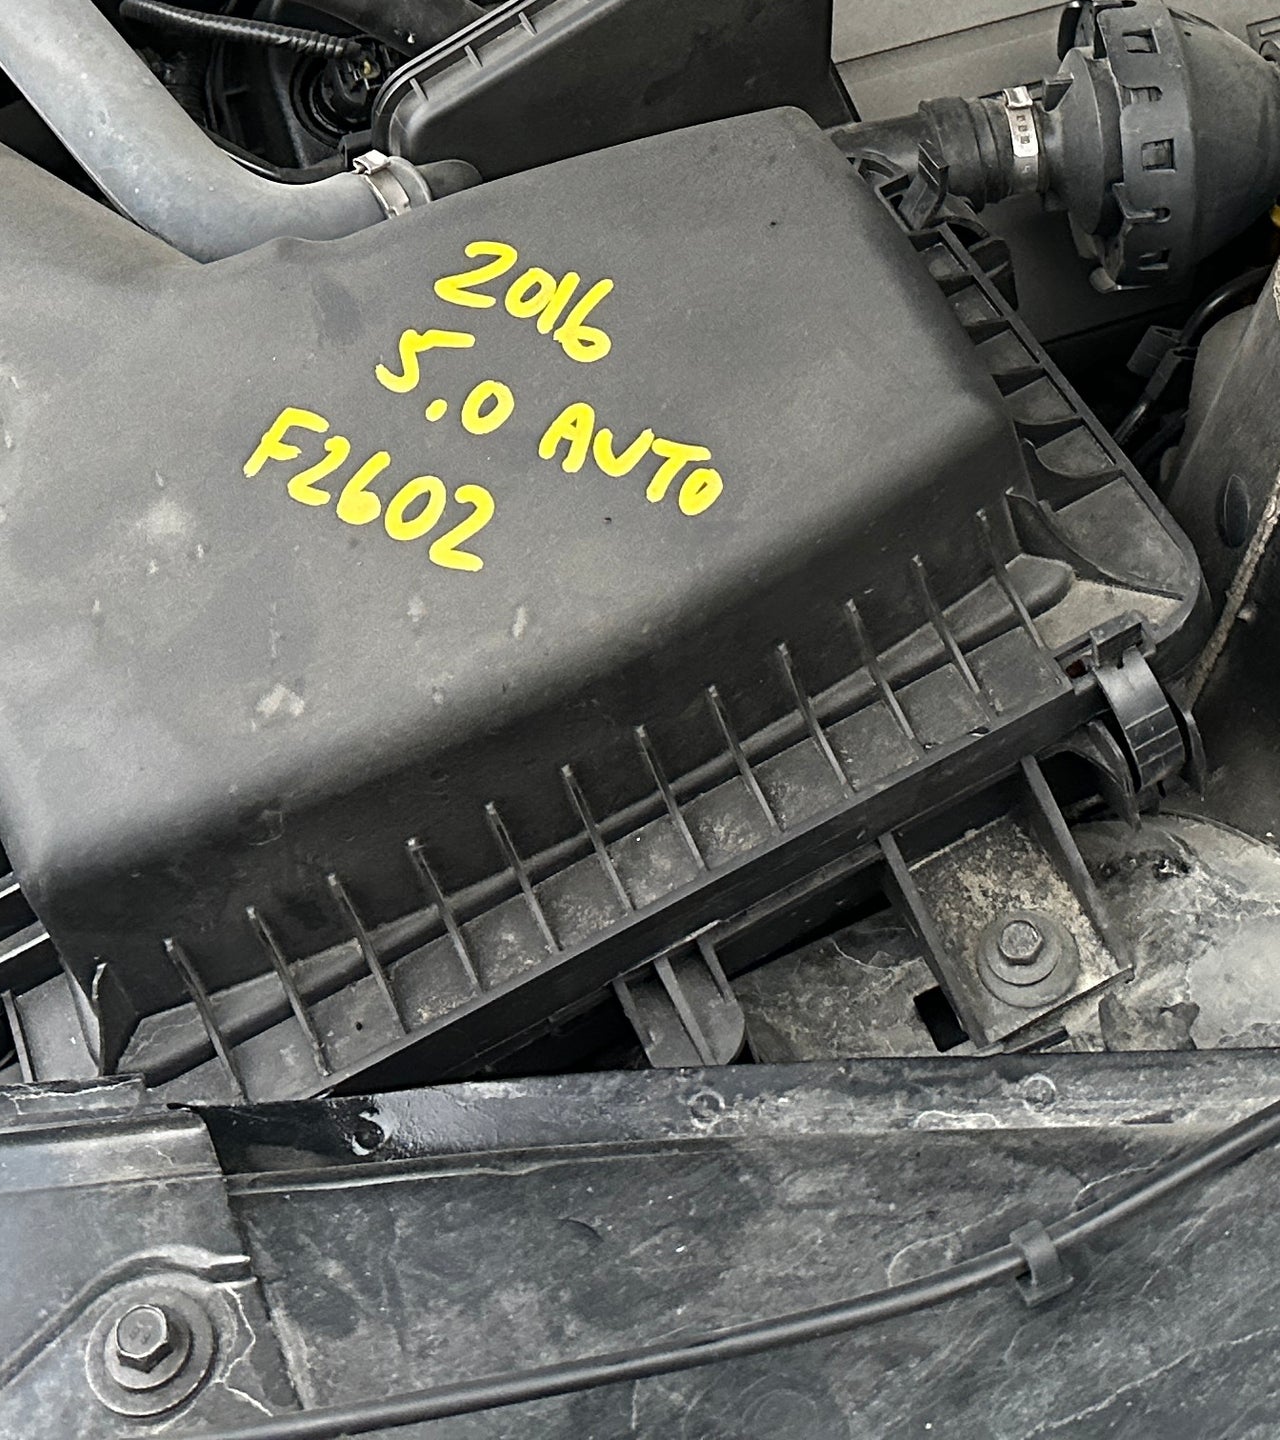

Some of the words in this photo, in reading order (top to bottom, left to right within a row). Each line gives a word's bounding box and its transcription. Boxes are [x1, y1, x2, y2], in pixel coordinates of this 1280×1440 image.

[433, 240, 615, 363] 2016
[242, 406, 496, 572] F2602
[374, 327, 516, 435] 5.0
[537, 401, 724, 516] AUTO
